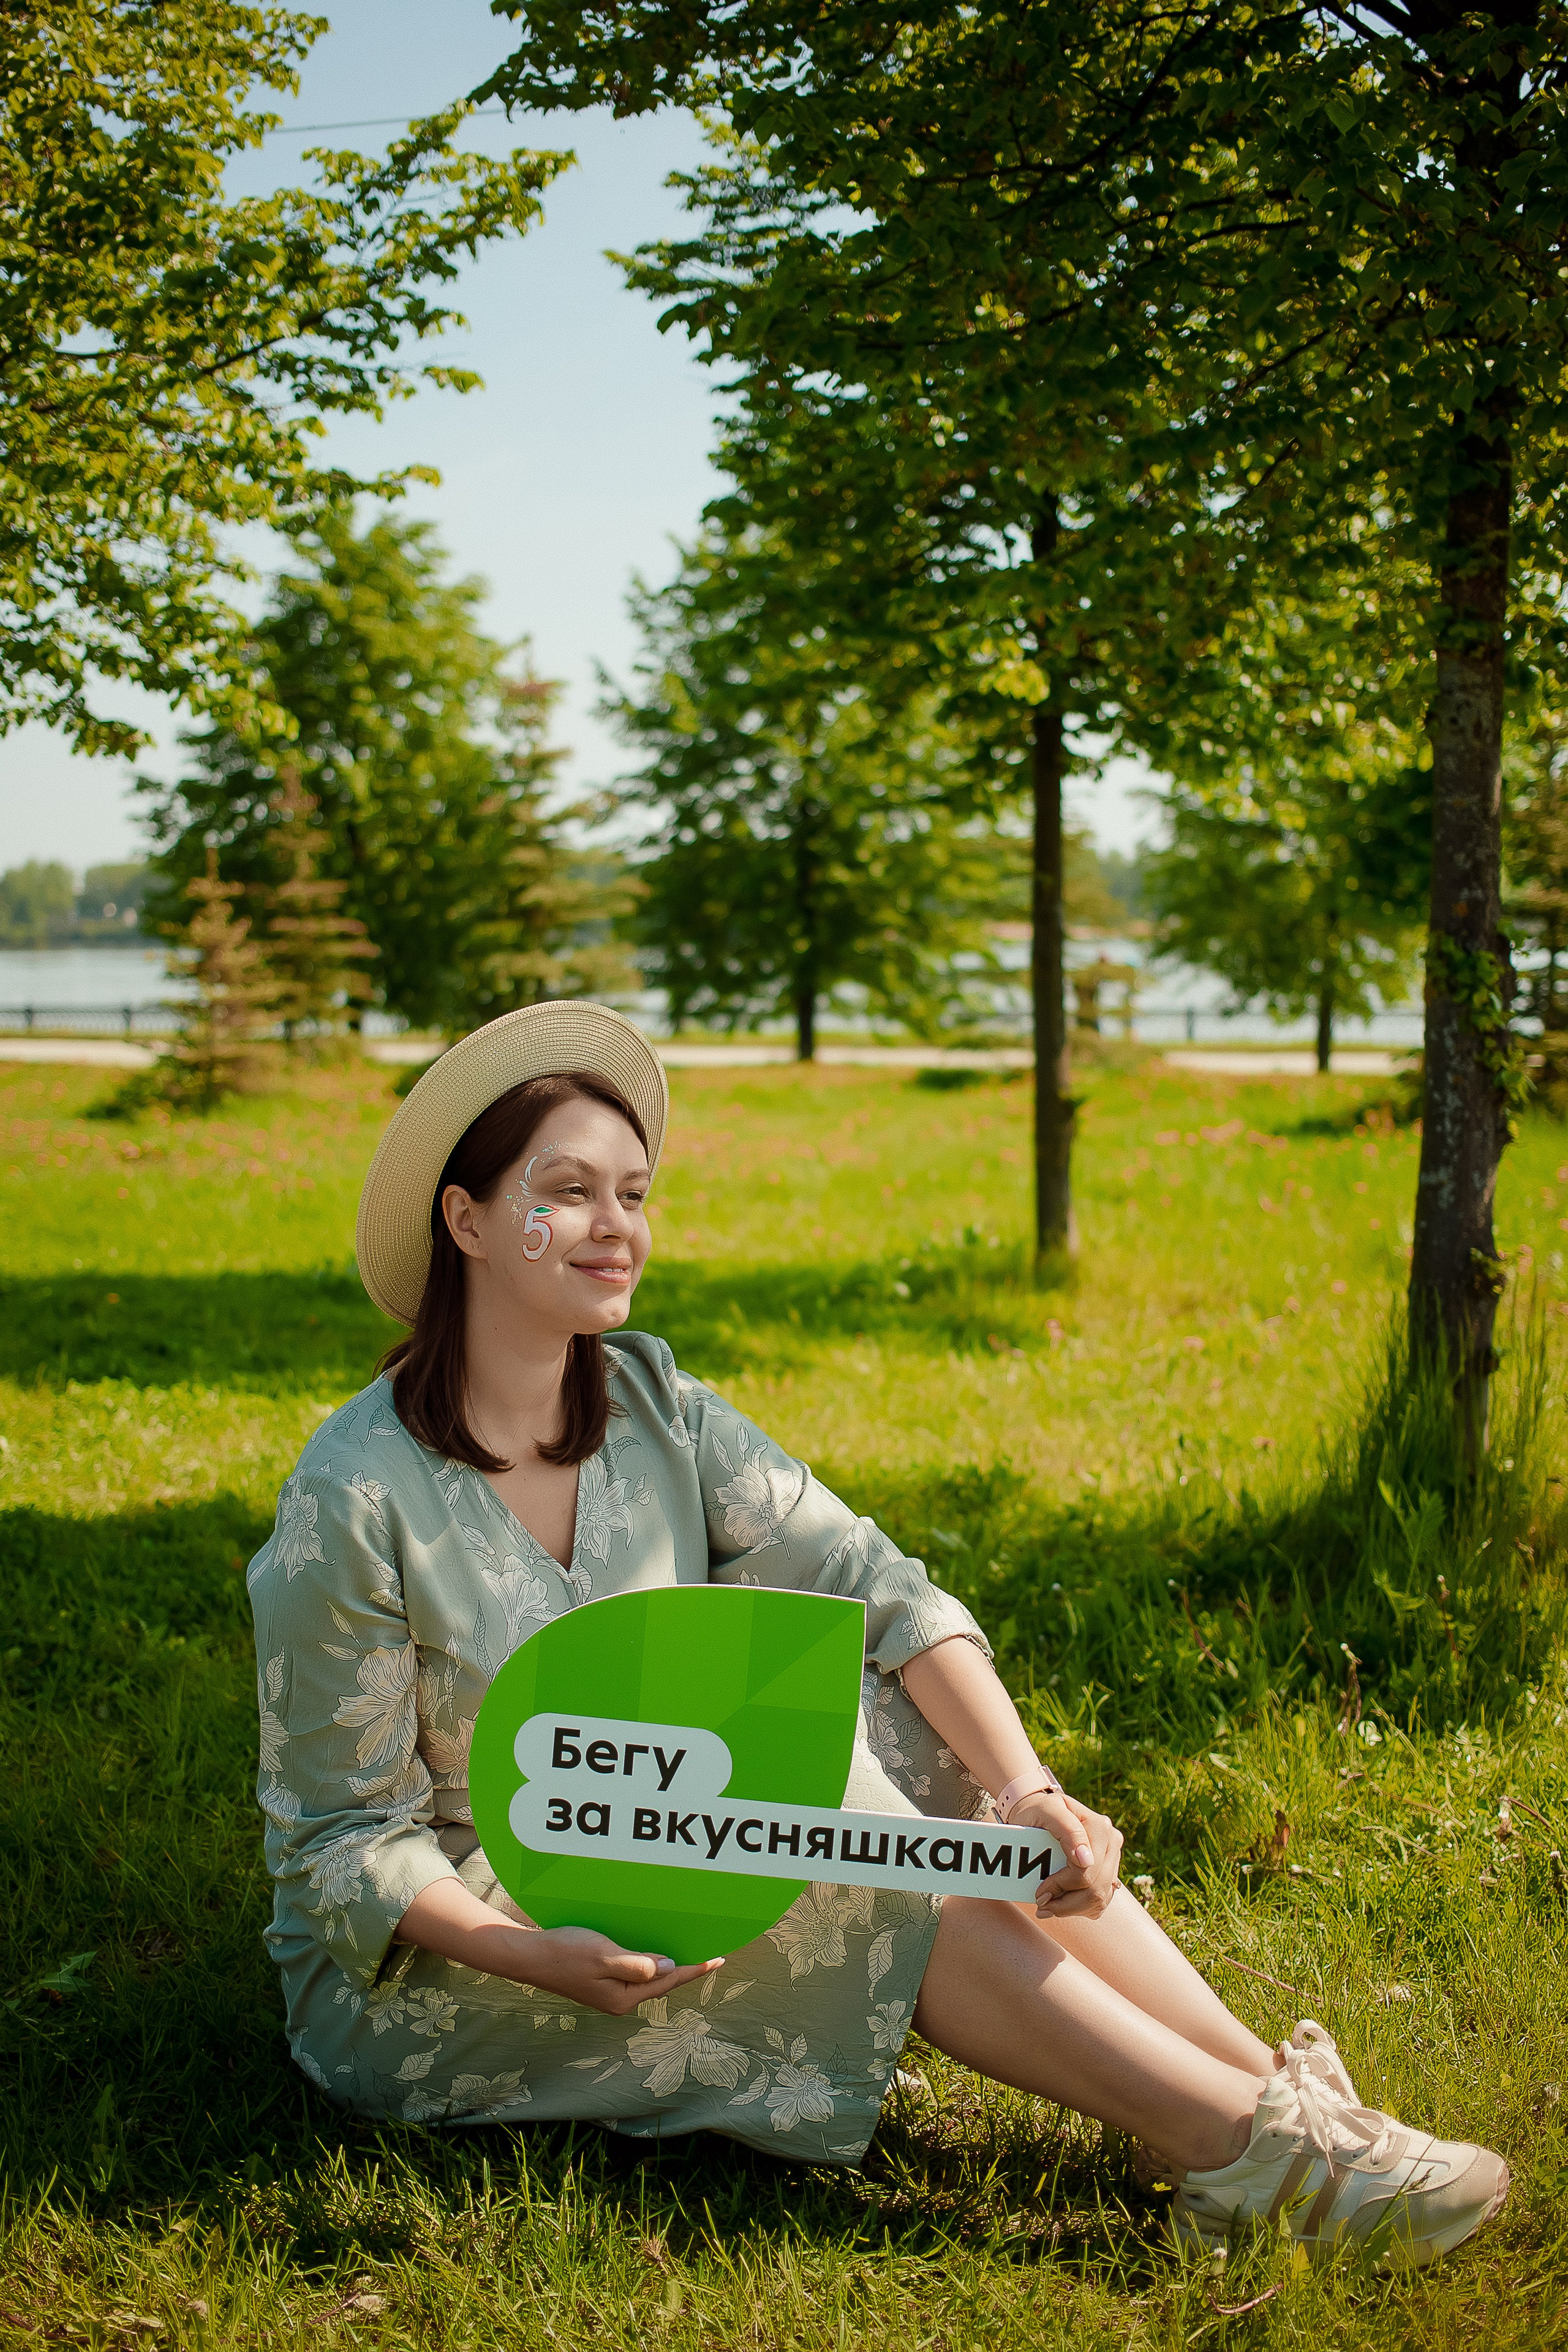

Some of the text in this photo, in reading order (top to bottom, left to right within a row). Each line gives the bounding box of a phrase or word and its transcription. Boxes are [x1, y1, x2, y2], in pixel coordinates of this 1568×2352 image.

[522, 1204, 560, 1262] 5
[552, 1727, 687, 1792] Бегу
[546, 1798, 1052, 1880] за вкусняшками
